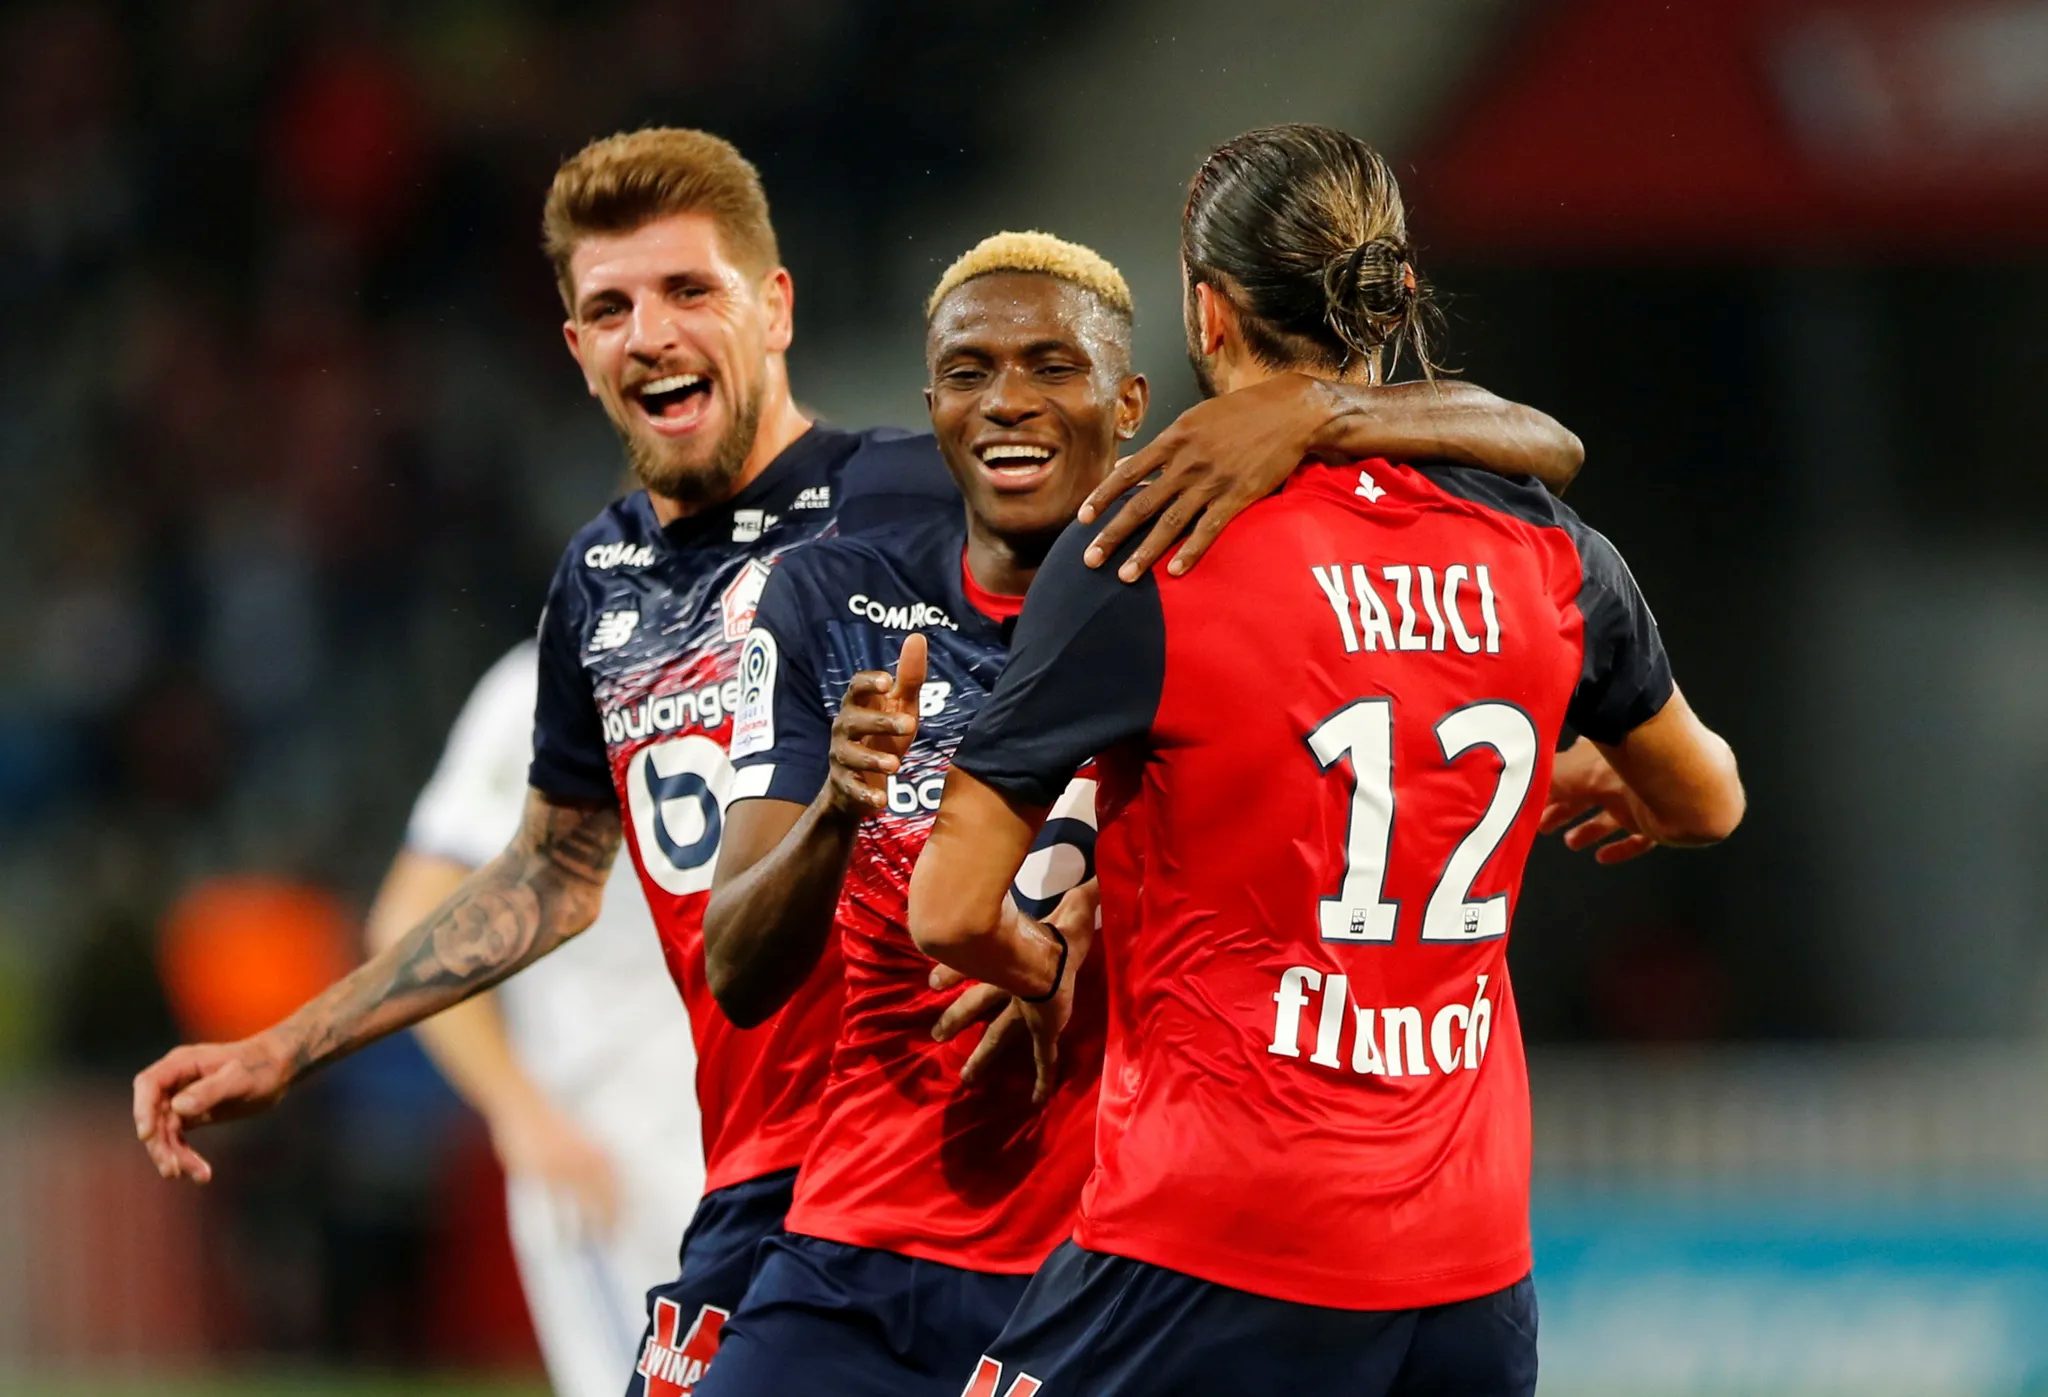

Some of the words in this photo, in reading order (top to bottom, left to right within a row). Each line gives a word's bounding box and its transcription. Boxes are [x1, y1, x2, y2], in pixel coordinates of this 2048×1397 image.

[1311, 564, 1501, 654] YAZICI
[1305, 700, 1538, 944] 12
[1350, 924, 1364, 933] LFP
[1464, 924, 1477, 932] LFP
[1268, 966, 1492, 1077] flunch
